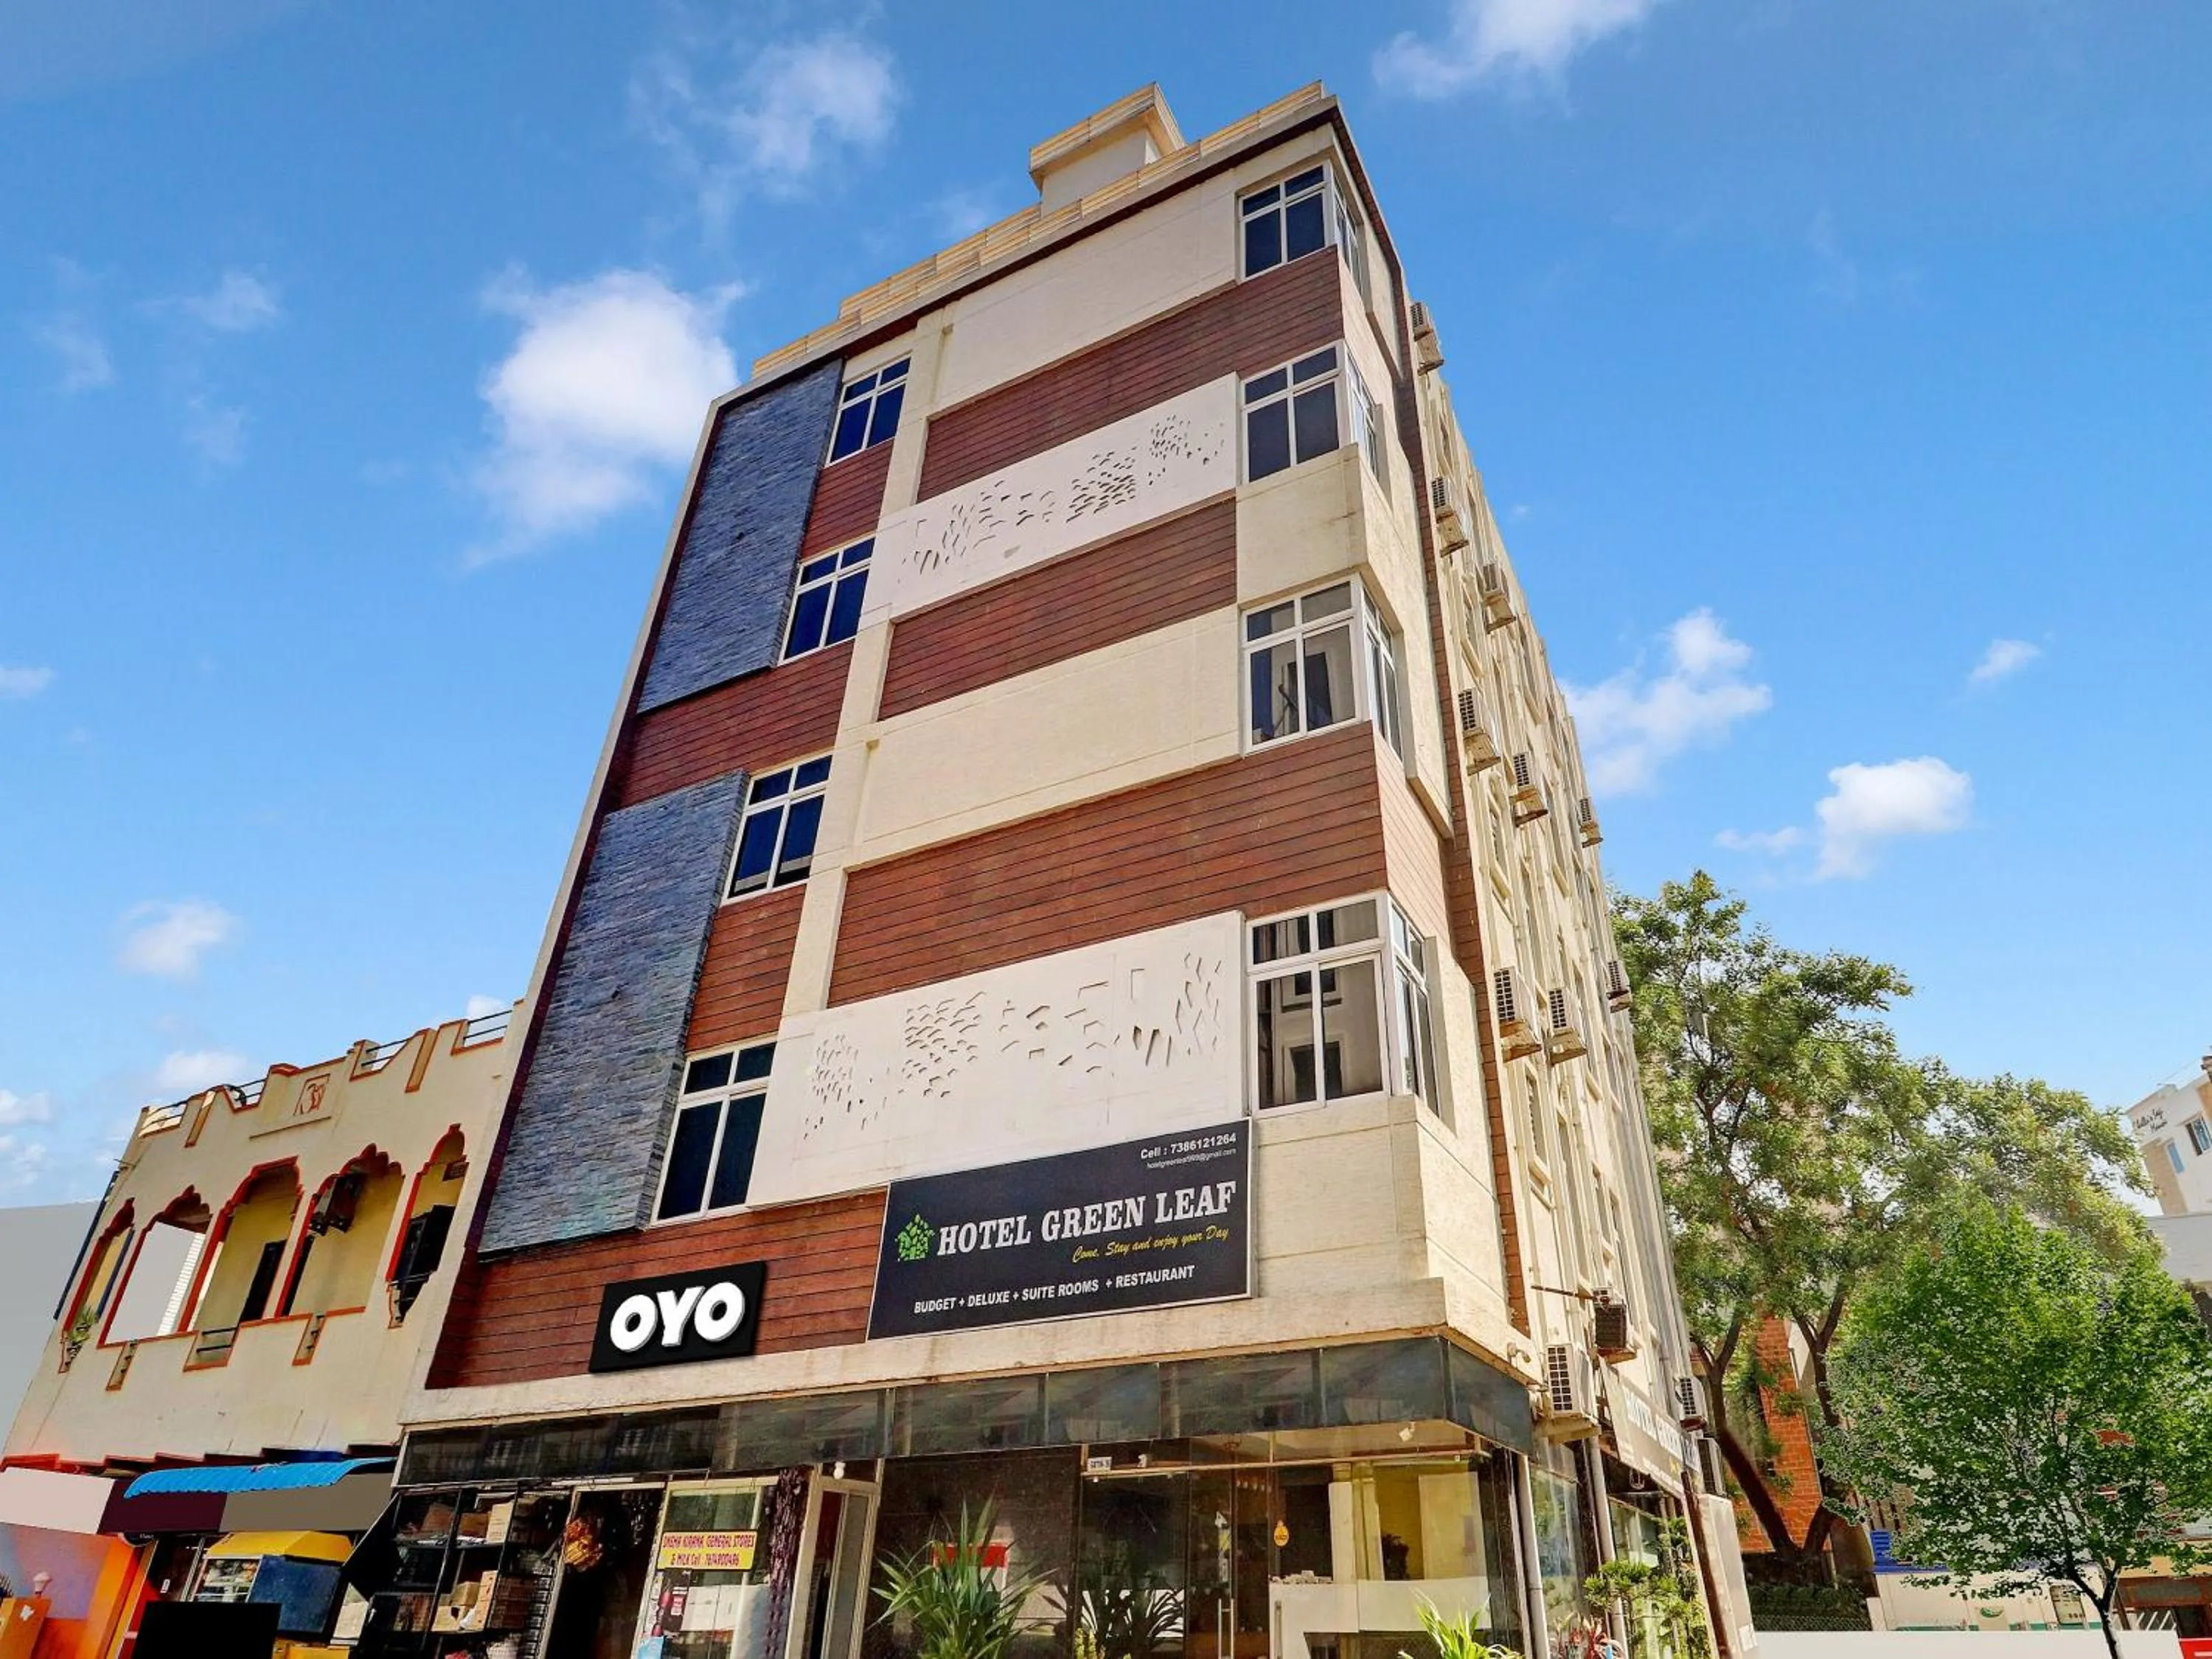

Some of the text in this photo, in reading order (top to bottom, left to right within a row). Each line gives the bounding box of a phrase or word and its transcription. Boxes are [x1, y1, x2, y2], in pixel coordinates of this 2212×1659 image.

[1141, 1147, 1161, 1159] Cell
[1170, 1133, 1237, 1154] 7386121264
[937, 1180, 1237, 1256] HOTEL GREEN LEAF
[1105, 1241, 1130, 1256] Stay
[1132, 1236, 1150, 1250] and
[1152, 1234, 1179, 1251] enjoy
[1180, 1231, 1203, 1247] your
[1205, 1225, 1230, 1241] Day
[914, 1297, 957, 1313] BUDGET
[967, 1290, 1010, 1307] DELUXE
[1021, 1285, 1055, 1301] SUITE
[1057, 1279, 1099, 1296] ROOMS
[1116, 1265, 1195, 1288] RESTAURANT
[610, 1281, 745, 1353] OYO
